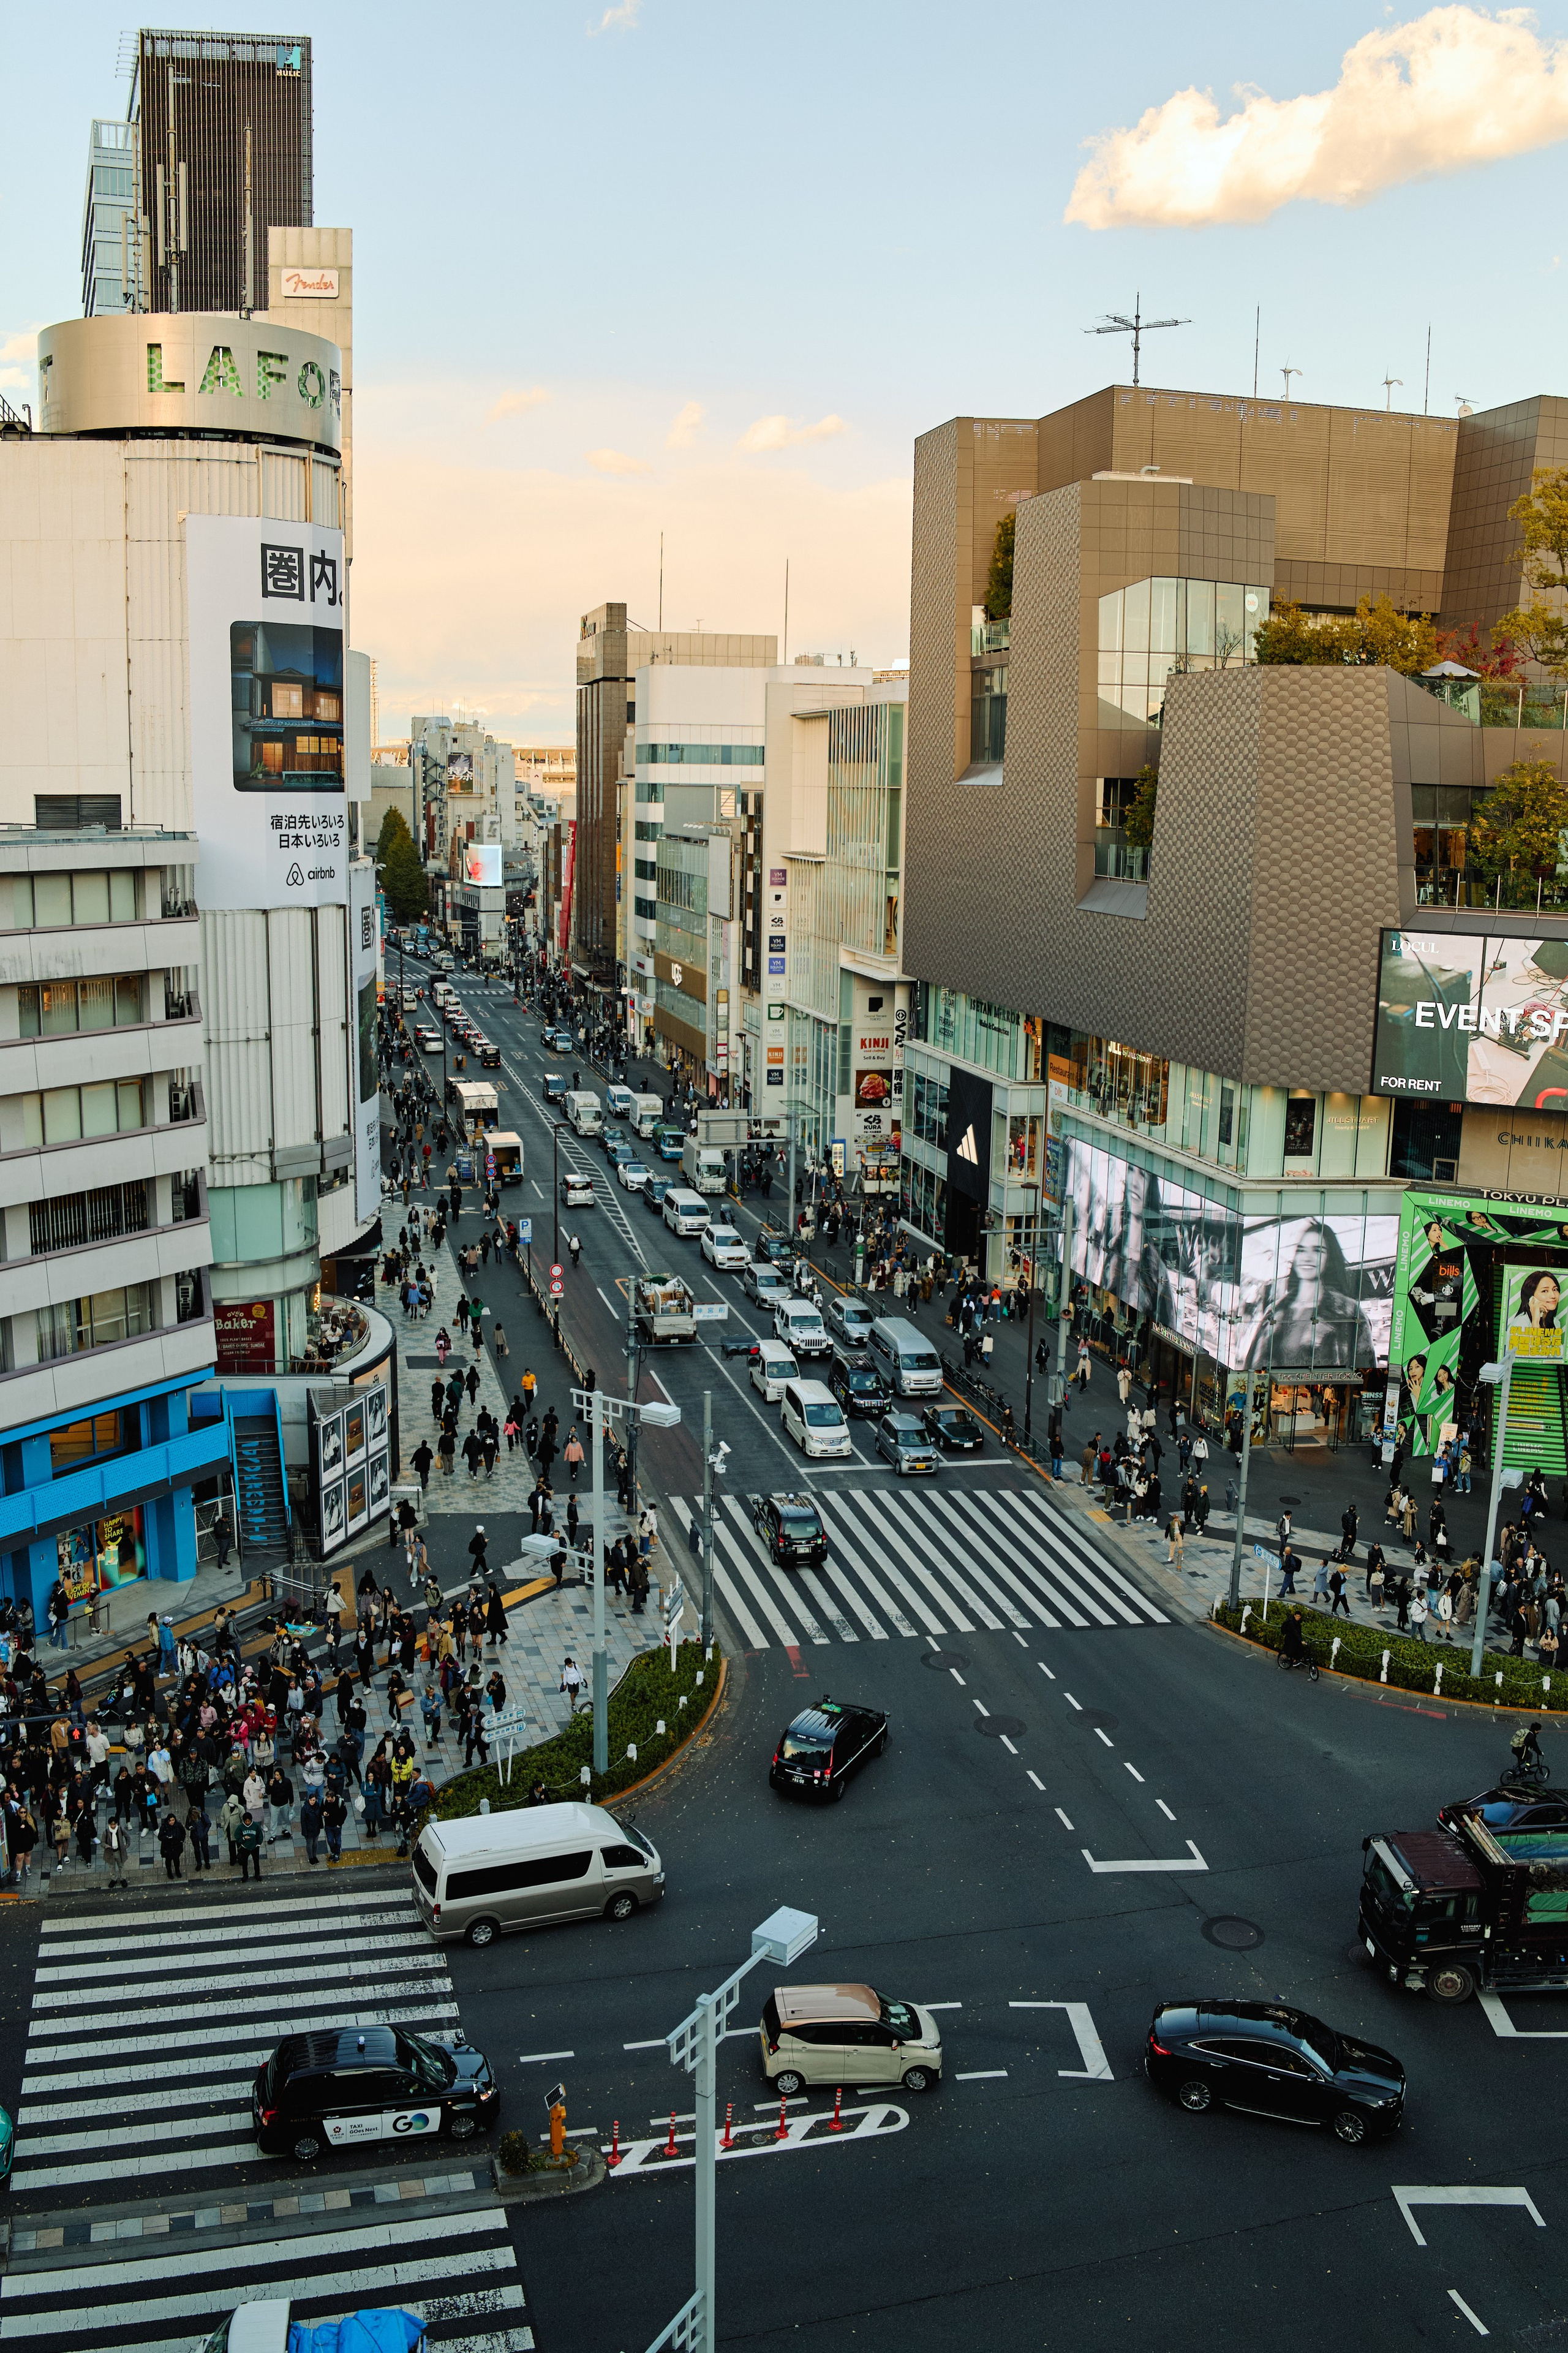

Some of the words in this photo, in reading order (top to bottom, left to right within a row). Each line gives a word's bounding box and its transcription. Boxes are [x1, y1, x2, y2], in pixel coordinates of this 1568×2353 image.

[285, 273, 335, 292] Fender
[271, 814, 344, 831] 宿泊先いろいろ
[279, 833, 340, 849] 日本いろいろ
[307, 863, 336, 881] airbnb
[1391, 939, 1439, 954] LOCUL
[970, 998, 992, 1016] ISETAN
[1415, 1000, 1524, 1035] EVENT
[860, 1037, 889, 1049] KINJI
[1108, 1040, 1121, 1056] JILL
[1381, 1076, 1406, 1089] FOR
[1408, 1078, 1442, 1092] RENT
[864, 1114, 881, 1125] くら
[1480, 1188, 1536, 1204] TOKYU
[1428, 1196, 1471, 1209] LINEMO
[1509, 1206, 1553, 1218] LINEMO
[521, 1220, 529, 1230] P
[1400, 1231, 1410, 1272] LINEMO
[1439, 1265, 1460, 1276] bills
[1393, 1309, 1403, 1350] LINEMO
[1510, 1326, 1563, 1336] #LINEMO
[374, 1437, 383, 1446] CELINE
[1512, 1442, 1544, 1454] LINEMO
[351, 1452, 361, 1460] CELINE
[328, 1467, 337, 1476] CELINE
[375, 1500, 384, 1509] CELINE
[104, 1516, 124, 1528] HAPPY
[353, 1516, 362, 1525] CELINE
[105, 1528, 124, 1540] SHARE
[330, 1533, 339, 1543] CELINE
[71, 1584, 81, 1595] JOY
[81, 1581, 90, 1590] OF
